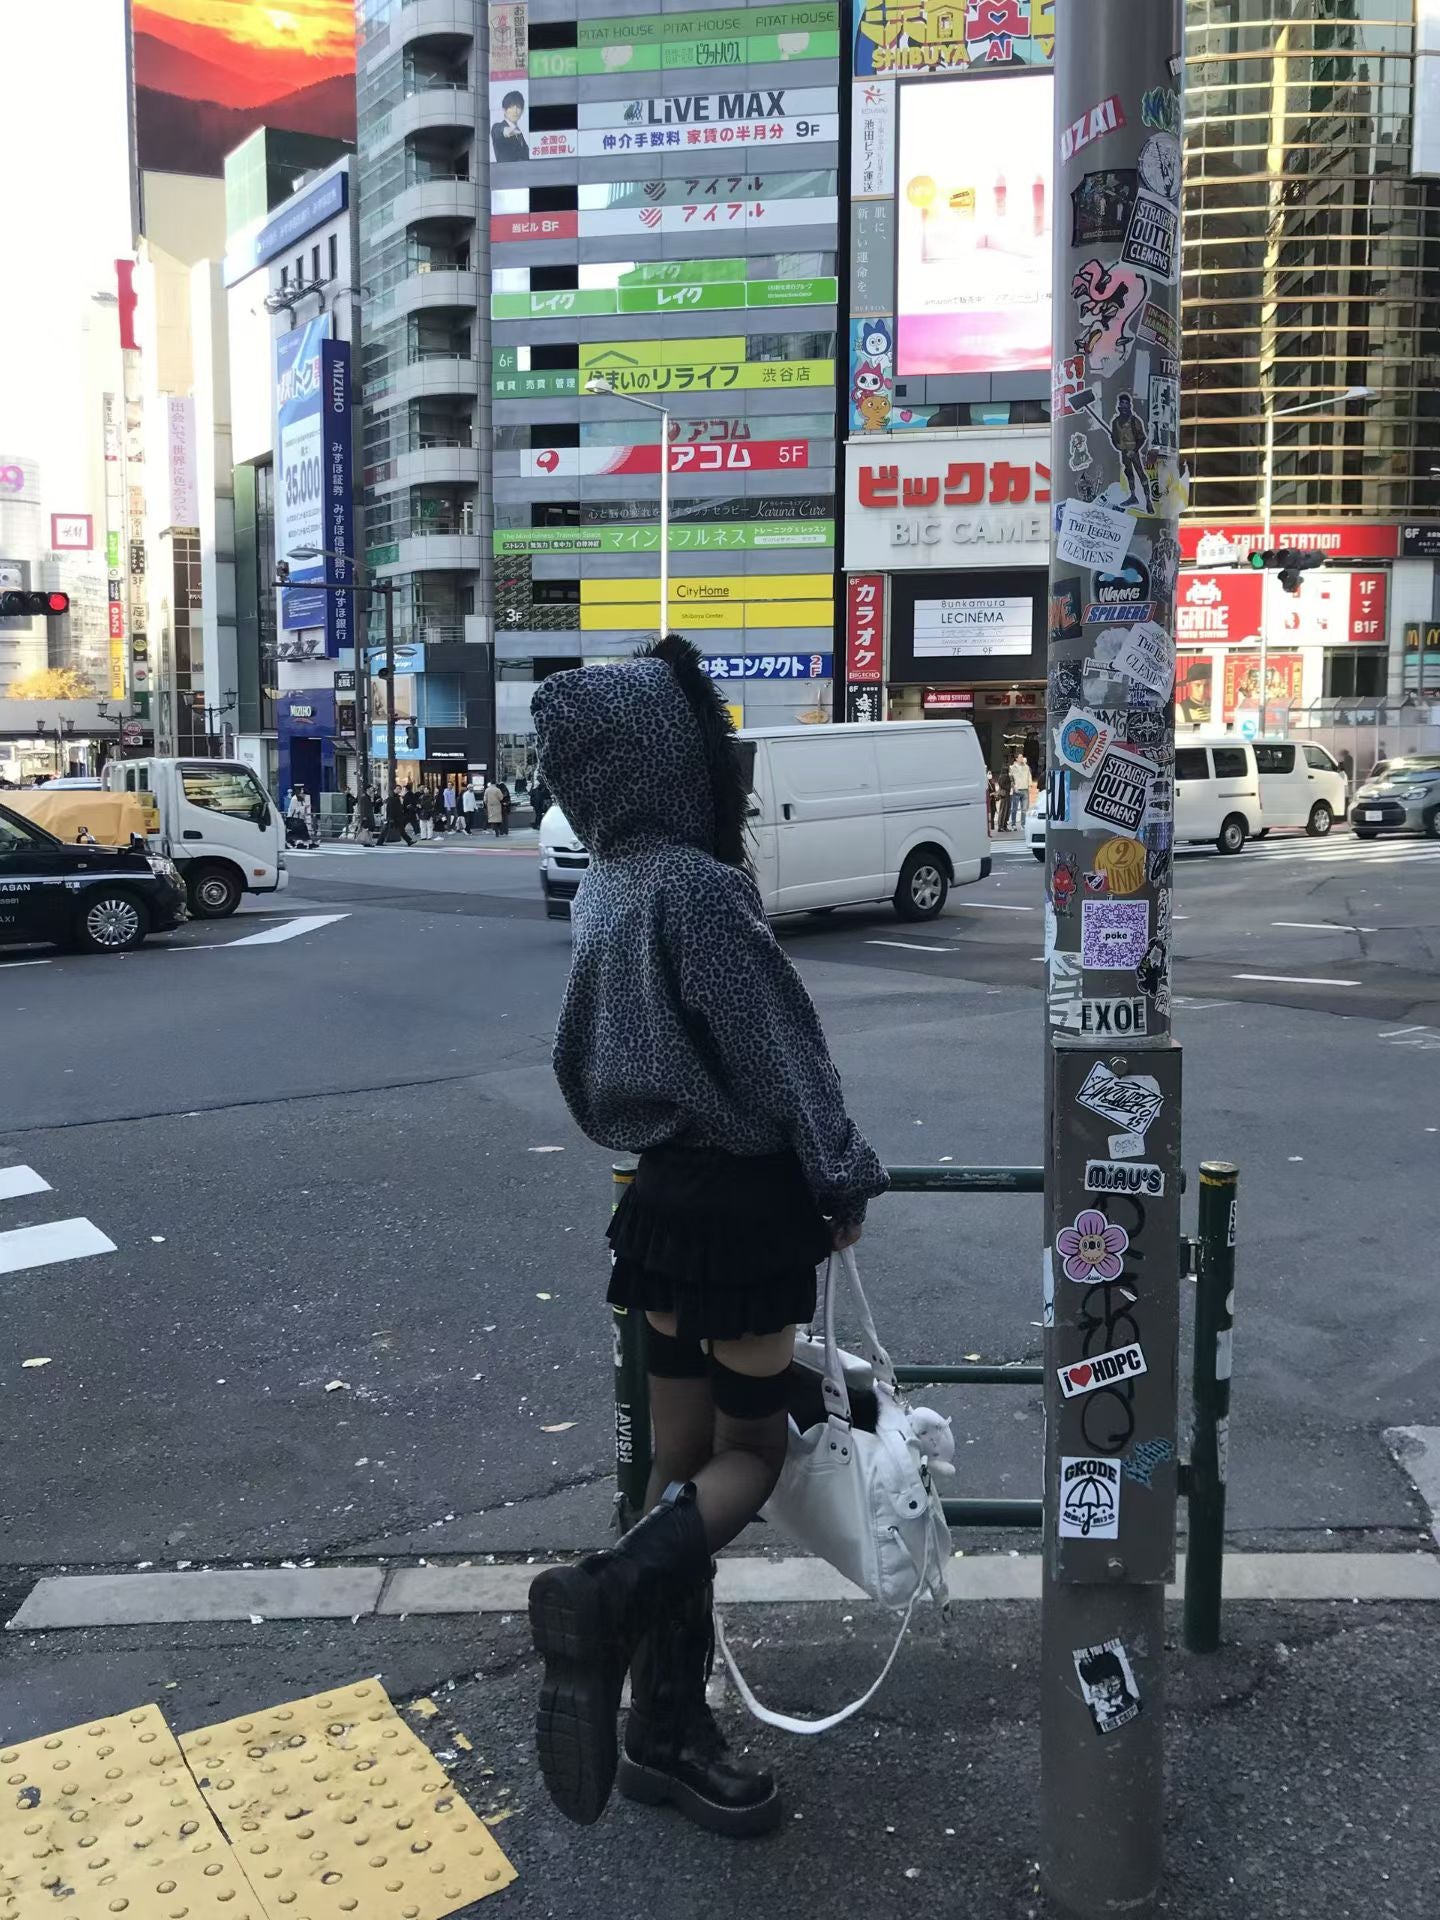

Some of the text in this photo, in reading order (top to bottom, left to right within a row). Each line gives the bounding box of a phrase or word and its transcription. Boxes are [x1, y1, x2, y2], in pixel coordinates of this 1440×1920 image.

[663, 18, 741, 34] PITAT HOUSE
[756, 11, 835, 27] PITAT HOUSE
[612, 24, 655, 39] HOUSE
[872, 44, 969, 71] SHIBUYA
[985, 39, 1012, 61] AI
[718, 91, 785, 119] MAX
[602, 121, 820, 150] 仲介手数料 家賃の半月分 9F
[1061, 99, 1118, 161] UZAI
[685, 177, 764, 196] アイフル
[682, 202, 765, 223] アイフル
[542, 220, 559, 232] 8F
[1130, 244, 1168, 272] CLEMENS
[530, 293, 576, 312] レイク
[657, 287, 702, 305] レイク
[499, 353, 514, 368] 6F
[762, 366, 812, 382] 渋谷店
[333, 360, 344, 413] MIZUHO
[688, 419, 751, 442] アコム
[670, 444, 804, 471] アコム 5F
[890, 520, 1050, 546] BIC CAME
[1280, 534, 1342, 549] STATION
[1405, 528, 1420, 538] 6F
[1063, 540, 1114, 564] CLEMENS
[132, 576, 144, 584] 3F
[1360, 581, 1376, 594] 1F
[677, 585, 729, 599] CityHome
[942, 600, 1005, 608] Bunkamura
[506, 609, 522, 622] 3F
[854, 584, 876, 668] カラオケ
[1354, 621, 1379, 634] B1F
[982, 646, 993, 654] 9F
[1082, 730, 1108, 770] KATRINA
[1097, 774, 1146, 809] OUTTA
[1094, 798, 1136, 824] CLEMENS
[1082, 1000, 1146, 1035] EXOE
[1091, 1350, 1142, 1382] HDPC
[1064, 1460, 1118, 1484] GKODE
